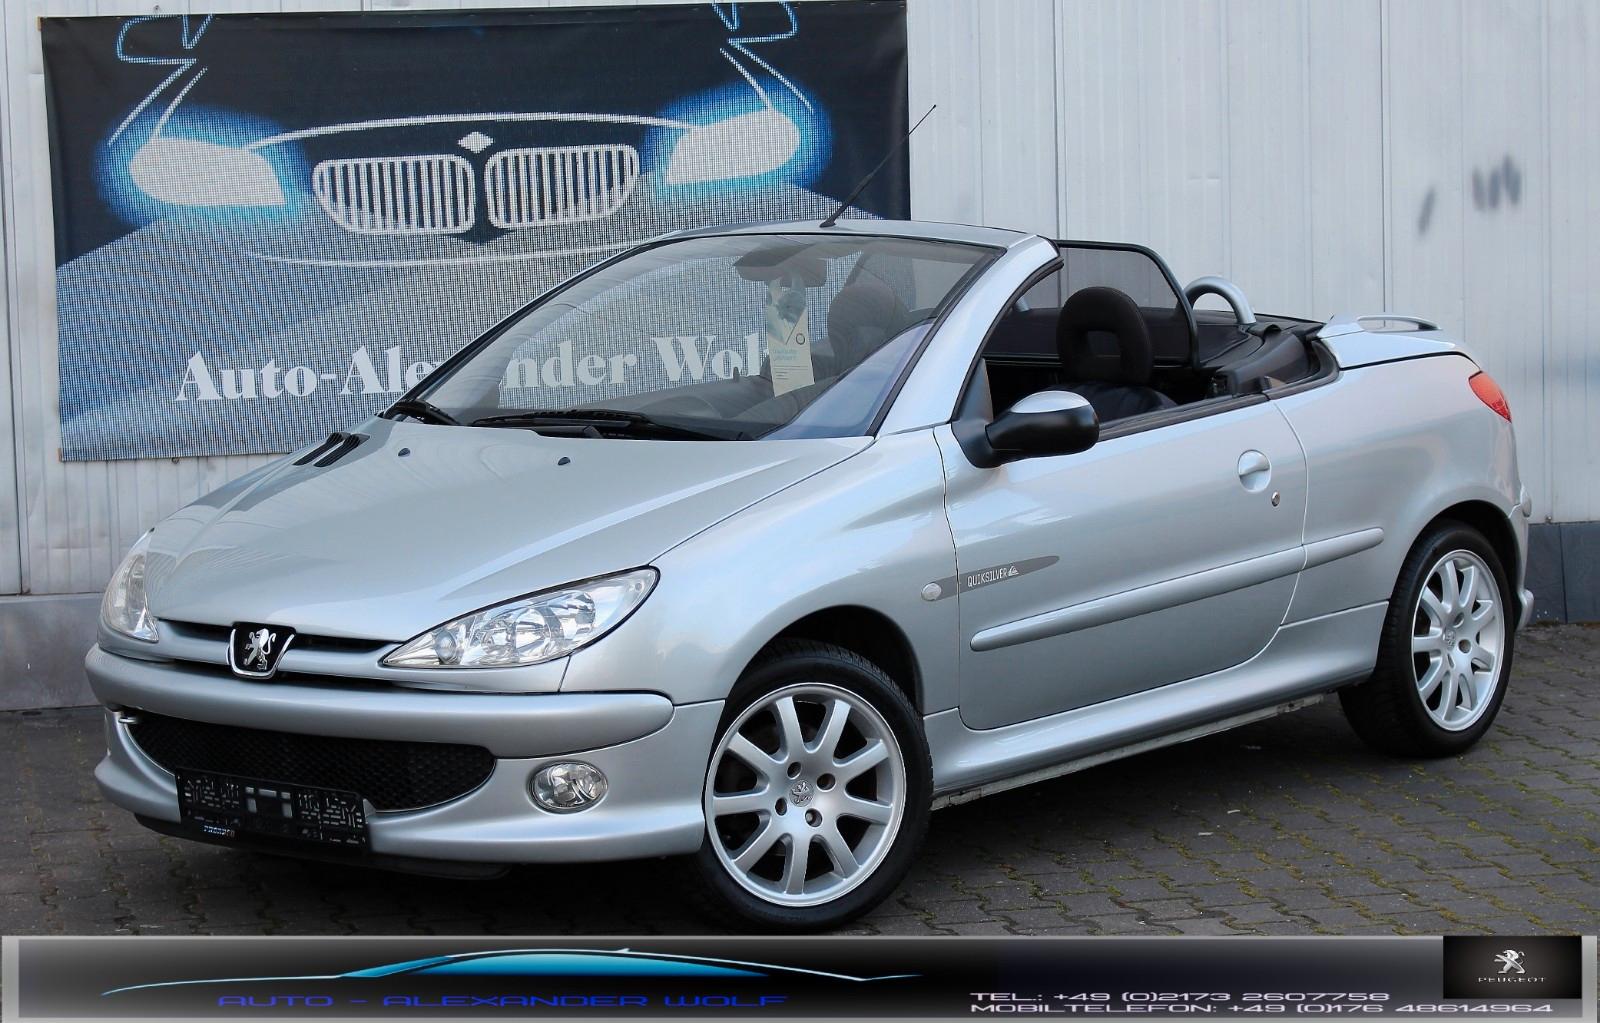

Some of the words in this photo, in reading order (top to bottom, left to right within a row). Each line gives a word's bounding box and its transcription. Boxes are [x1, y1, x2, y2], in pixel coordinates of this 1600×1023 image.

[176, 338, 637, 401] Auto-Alender
[651, 332, 769, 382] Wol
[967, 567, 1008, 588] QUIKSILVER
